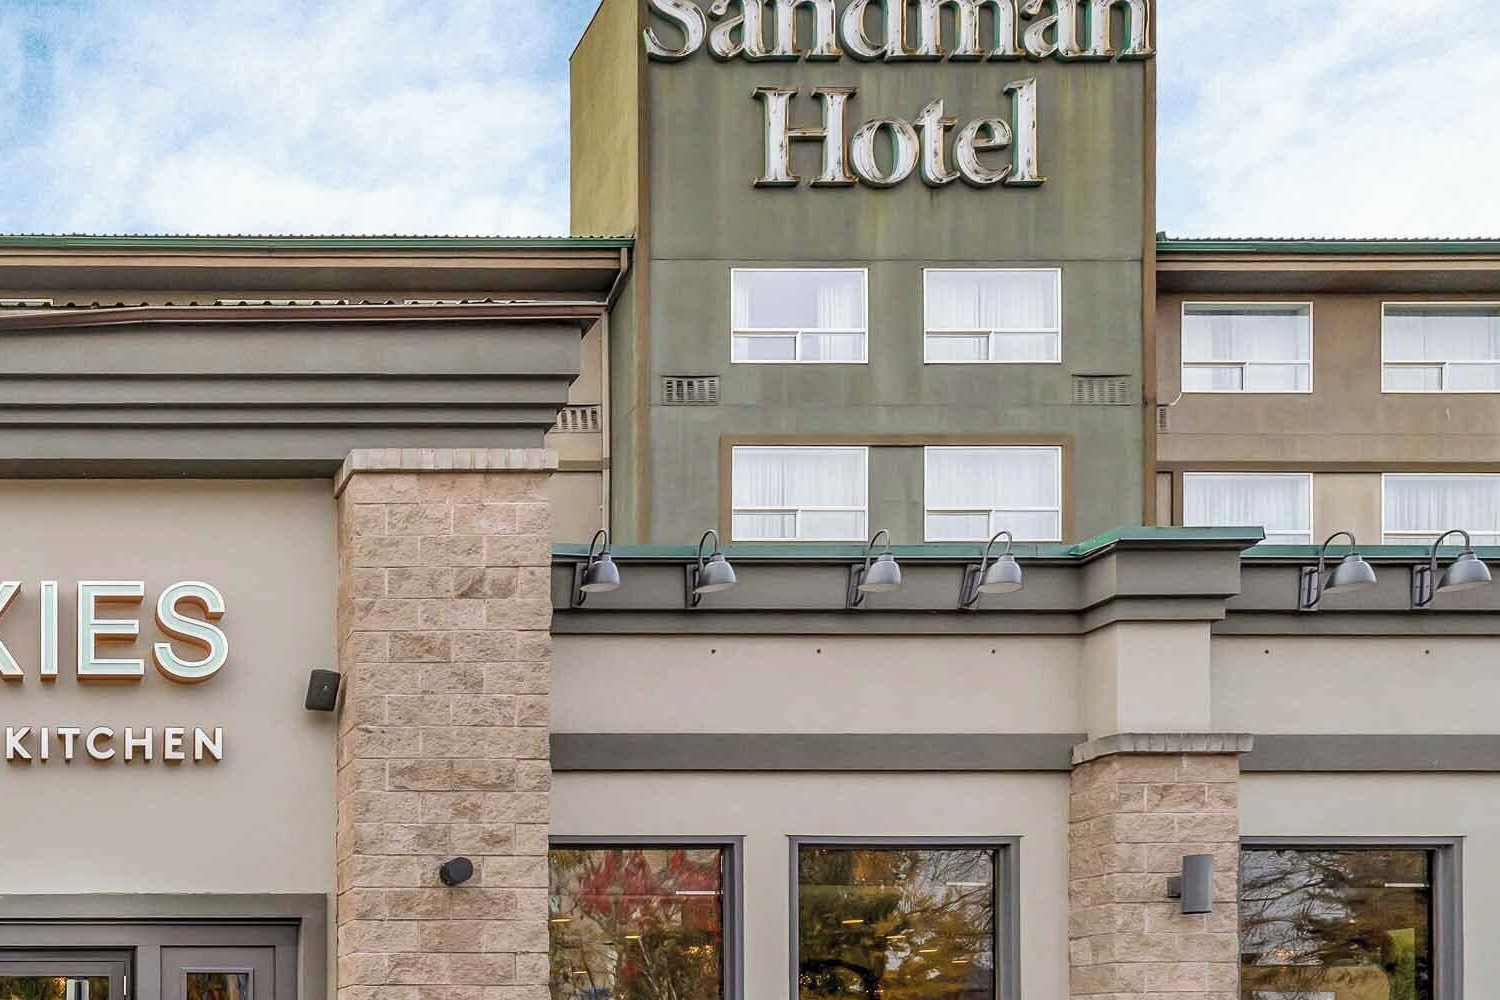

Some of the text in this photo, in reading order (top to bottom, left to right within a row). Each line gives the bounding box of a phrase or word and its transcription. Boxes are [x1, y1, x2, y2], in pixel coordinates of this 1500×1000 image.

[644, 0, 1156, 62] Sandman
[751, 78, 1047, 188] Hotel
[5, 726, 224, 763] KITCHEN
